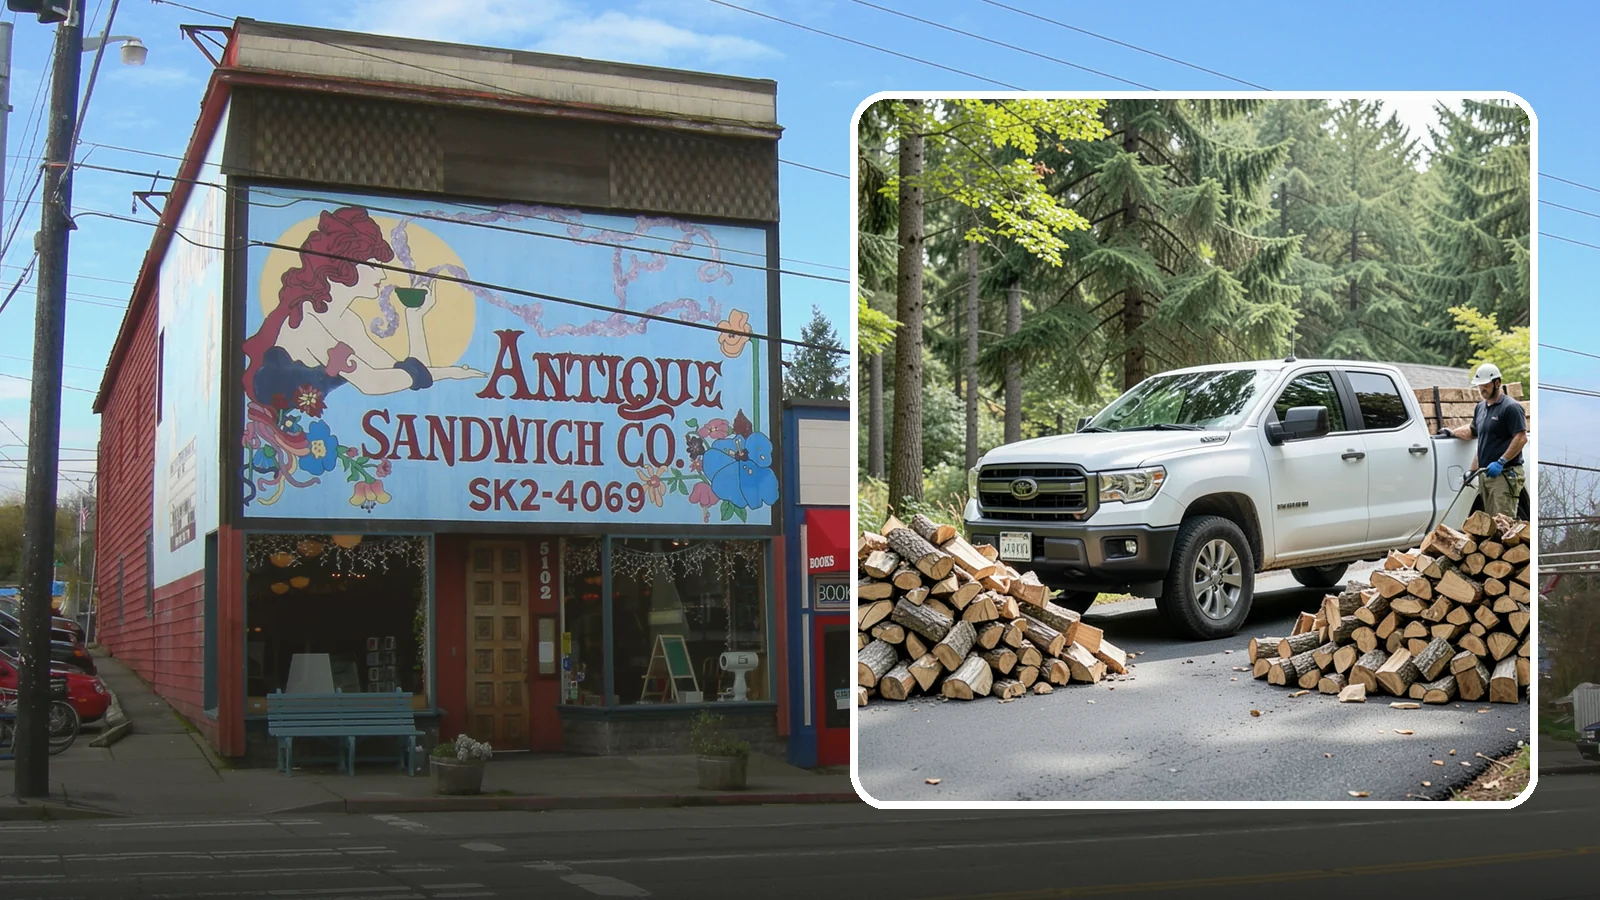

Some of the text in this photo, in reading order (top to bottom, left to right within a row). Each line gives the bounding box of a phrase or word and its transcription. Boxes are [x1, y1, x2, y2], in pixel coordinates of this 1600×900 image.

[475, 328, 724, 421] ANTIQUE
[360, 408, 686, 470] SANDWICH CO.
[467, 476, 647, 514] SK2-4069
[540, 541, 551, 600] 5102
[809, 555, 835, 569] BOOKS
